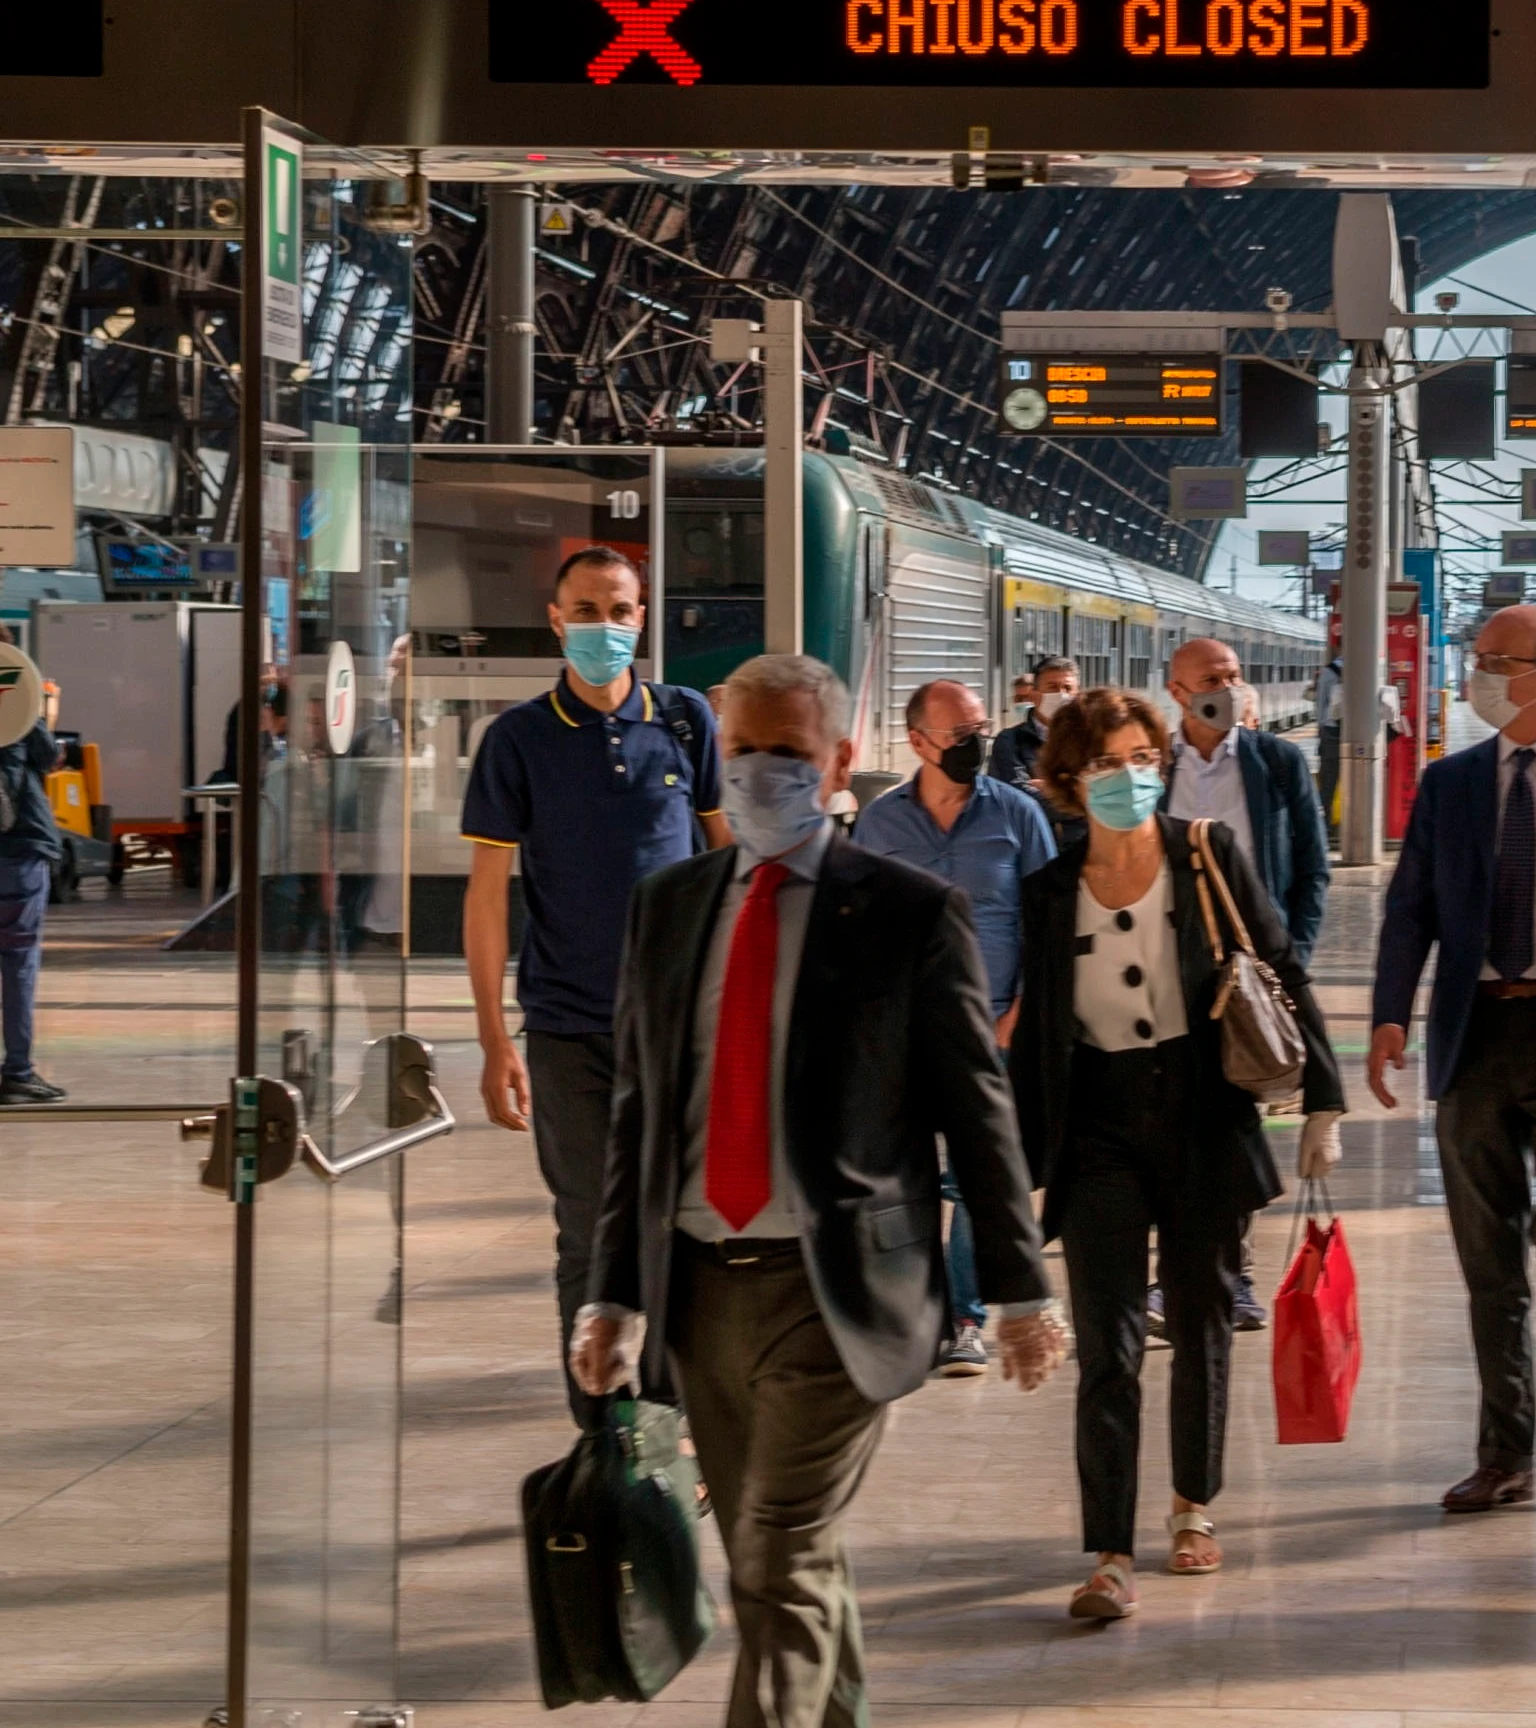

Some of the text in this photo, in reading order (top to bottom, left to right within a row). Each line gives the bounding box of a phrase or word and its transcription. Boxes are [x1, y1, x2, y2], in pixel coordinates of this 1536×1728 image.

[845, 0, 1369, 56] CHIUSO CLOSED
[606, 490, 640, 519] 10
